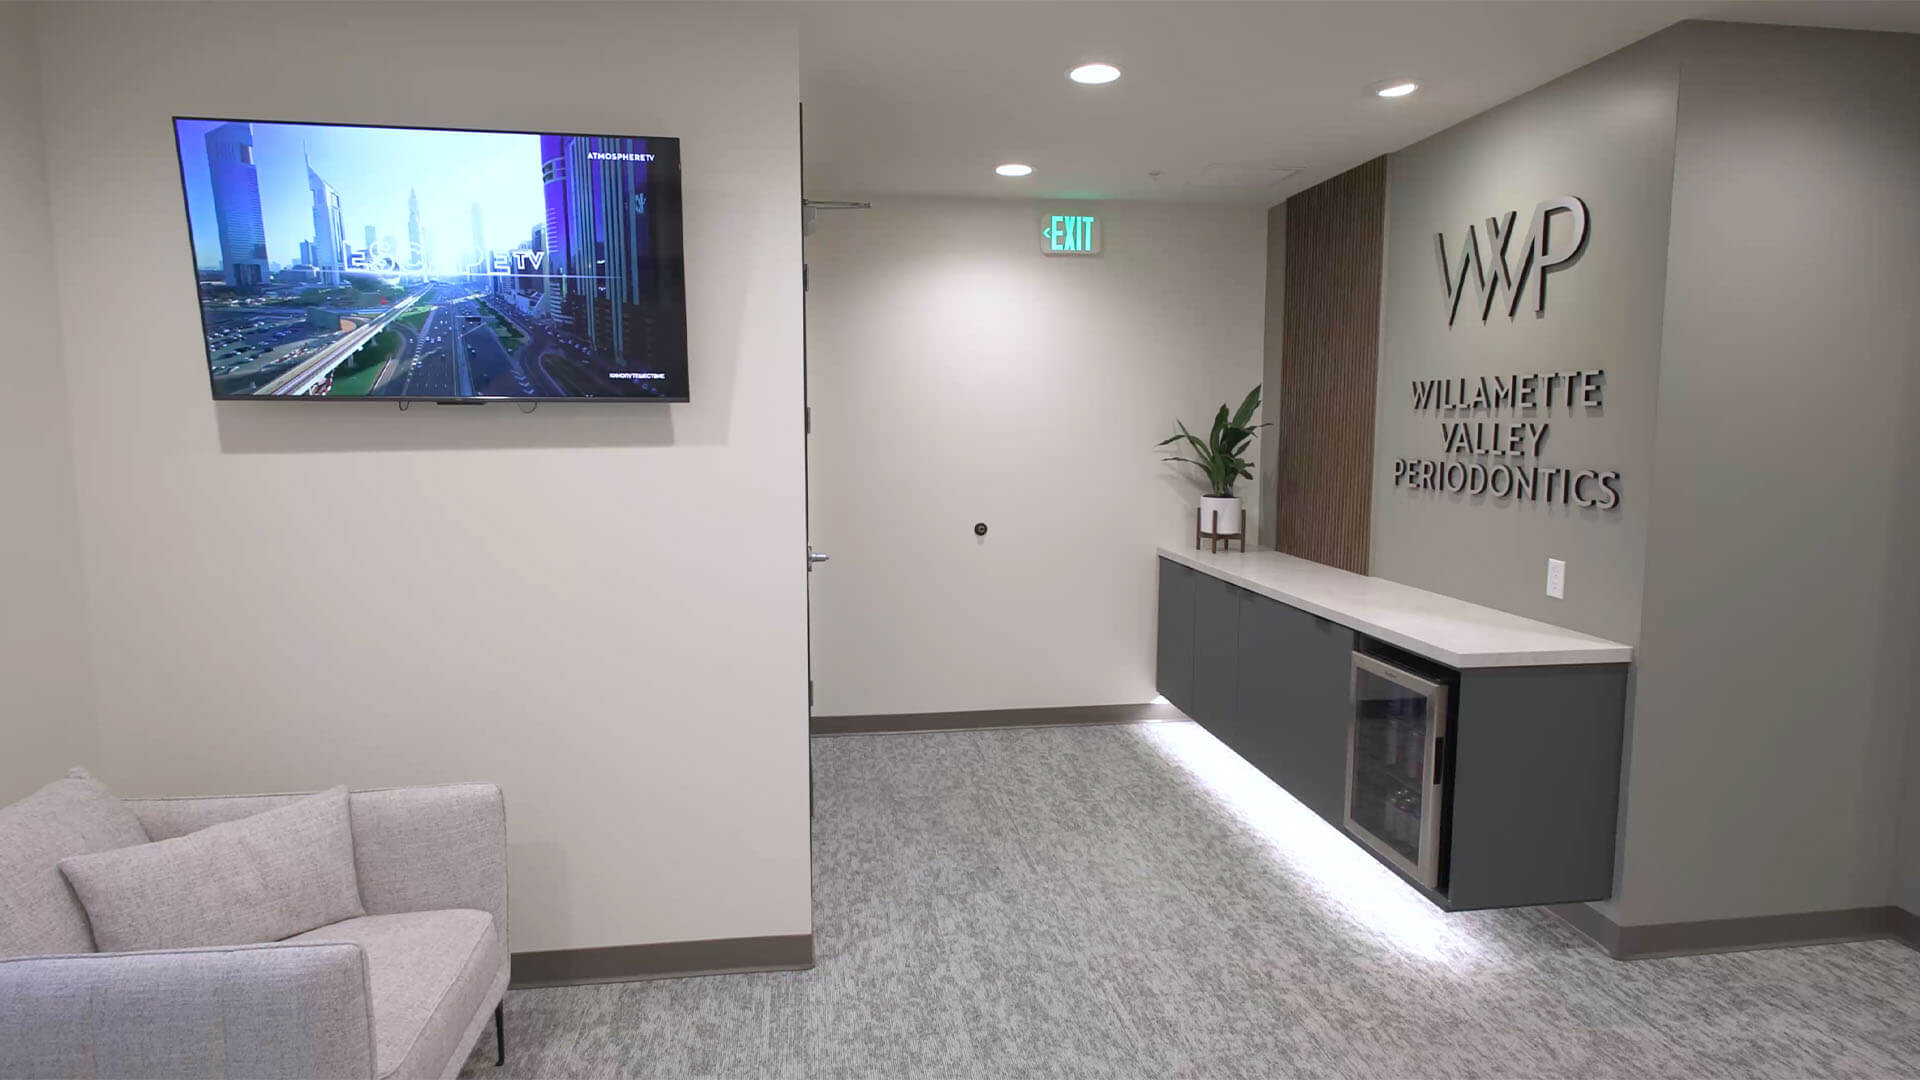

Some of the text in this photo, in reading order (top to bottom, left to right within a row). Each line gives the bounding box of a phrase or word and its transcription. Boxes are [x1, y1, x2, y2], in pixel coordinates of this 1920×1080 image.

[1051, 215, 1094, 251] EXIT
[1412, 369, 1604, 410] WILLAMETTE
[1441, 423, 1549, 457] VALLEY
[1395, 458, 1621, 511] PERIODONTICS
